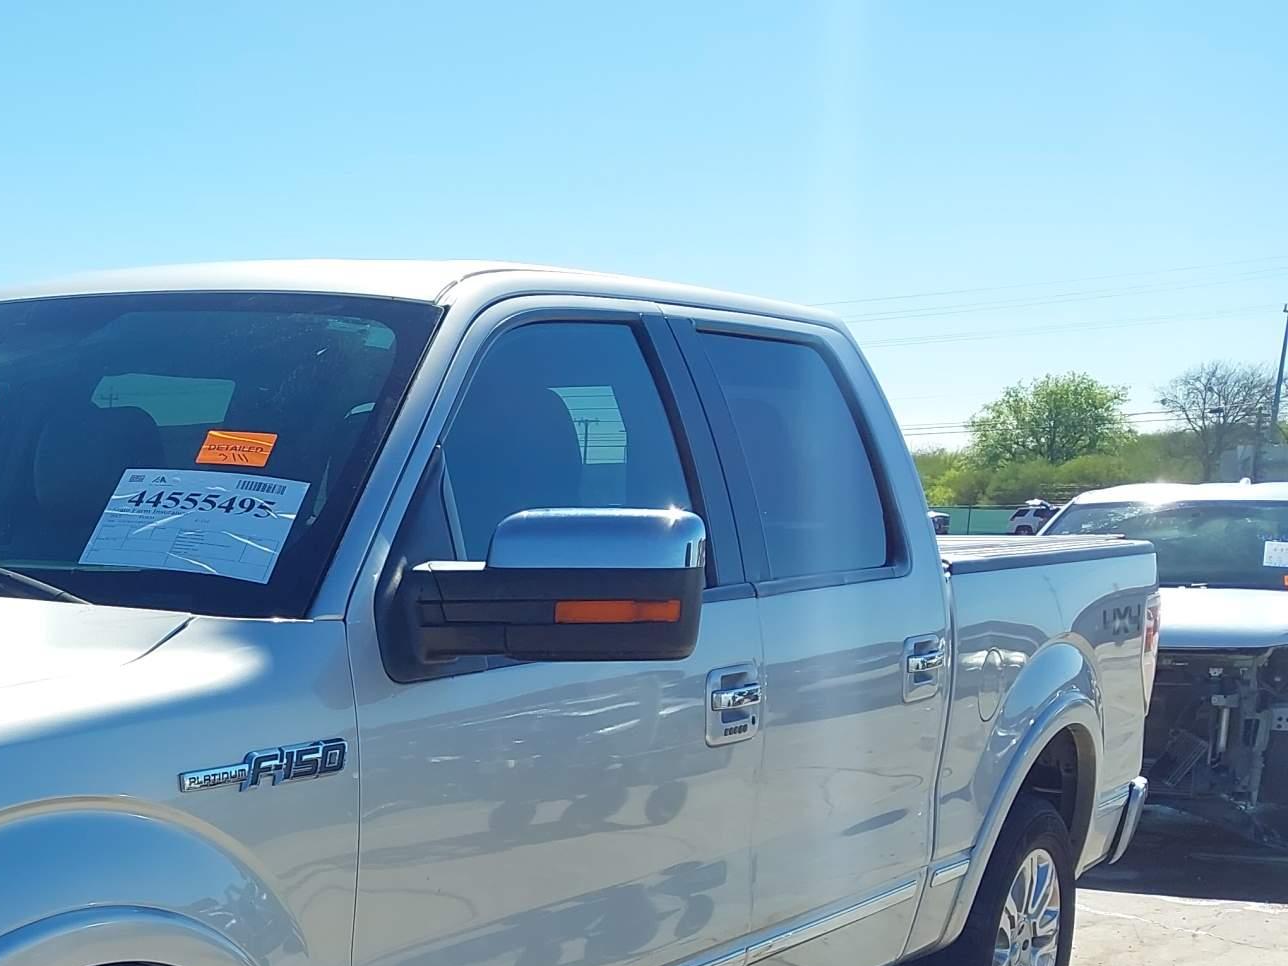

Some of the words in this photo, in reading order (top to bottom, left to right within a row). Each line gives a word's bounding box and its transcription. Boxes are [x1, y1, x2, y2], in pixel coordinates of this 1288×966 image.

[207, 444, 264, 454] DETAILED
[127, 490, 276, 518] 44555495
[188, 768, 247, 787] PLATINUM
